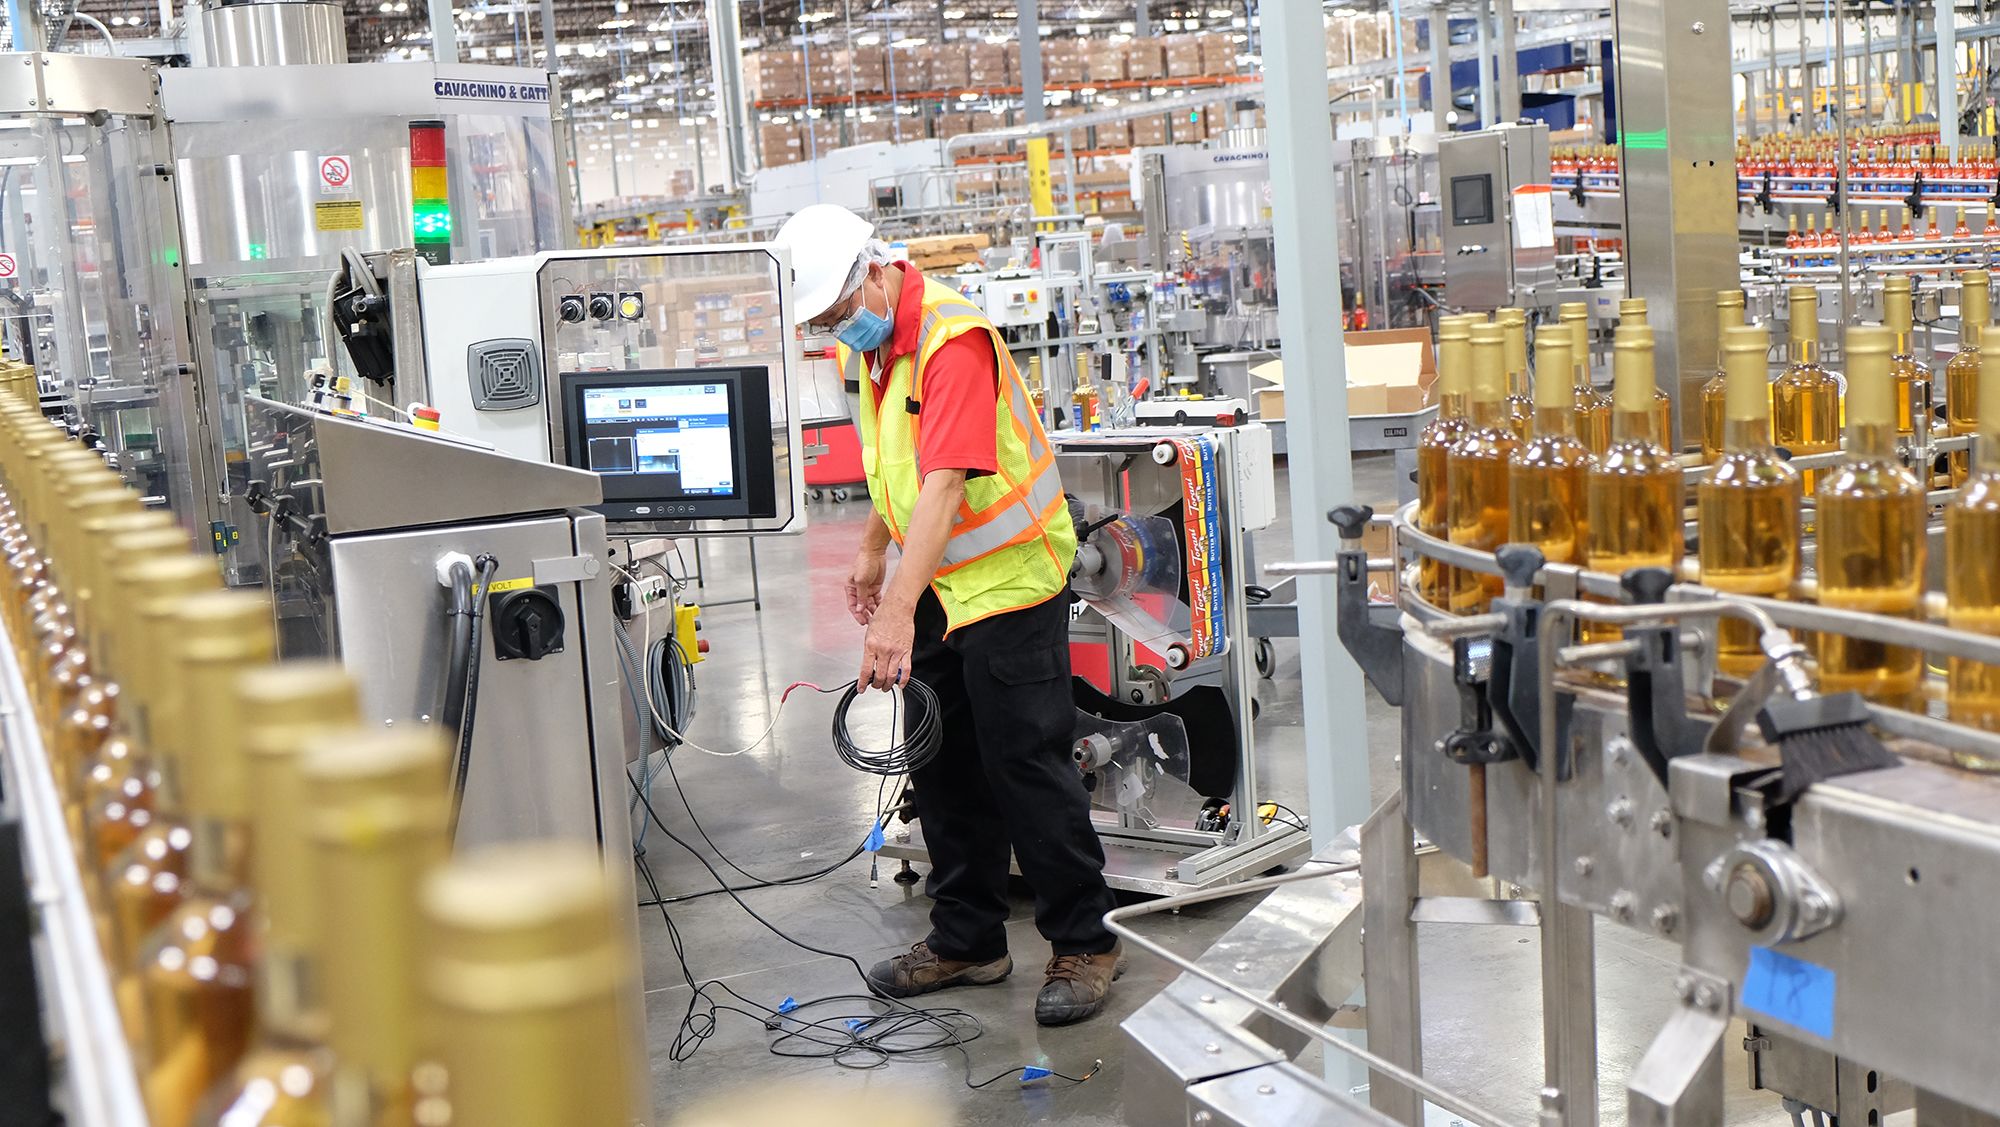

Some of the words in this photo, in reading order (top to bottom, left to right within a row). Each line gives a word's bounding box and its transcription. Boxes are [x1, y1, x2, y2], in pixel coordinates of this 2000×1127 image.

[434, 81, 506, 99] CAVAGNINO
[509, 85, 517, 99] &
[520, 86, 549, 100] GATT
[1213, 152, 1264, 162] CAVAGNINO
[1185, 478, 1200, 516] Torani
[1188, 528, 1203, 567] Torani
[490, 581, 513, 590] VOLT
[1192, 579, 1206, 617] Torani
